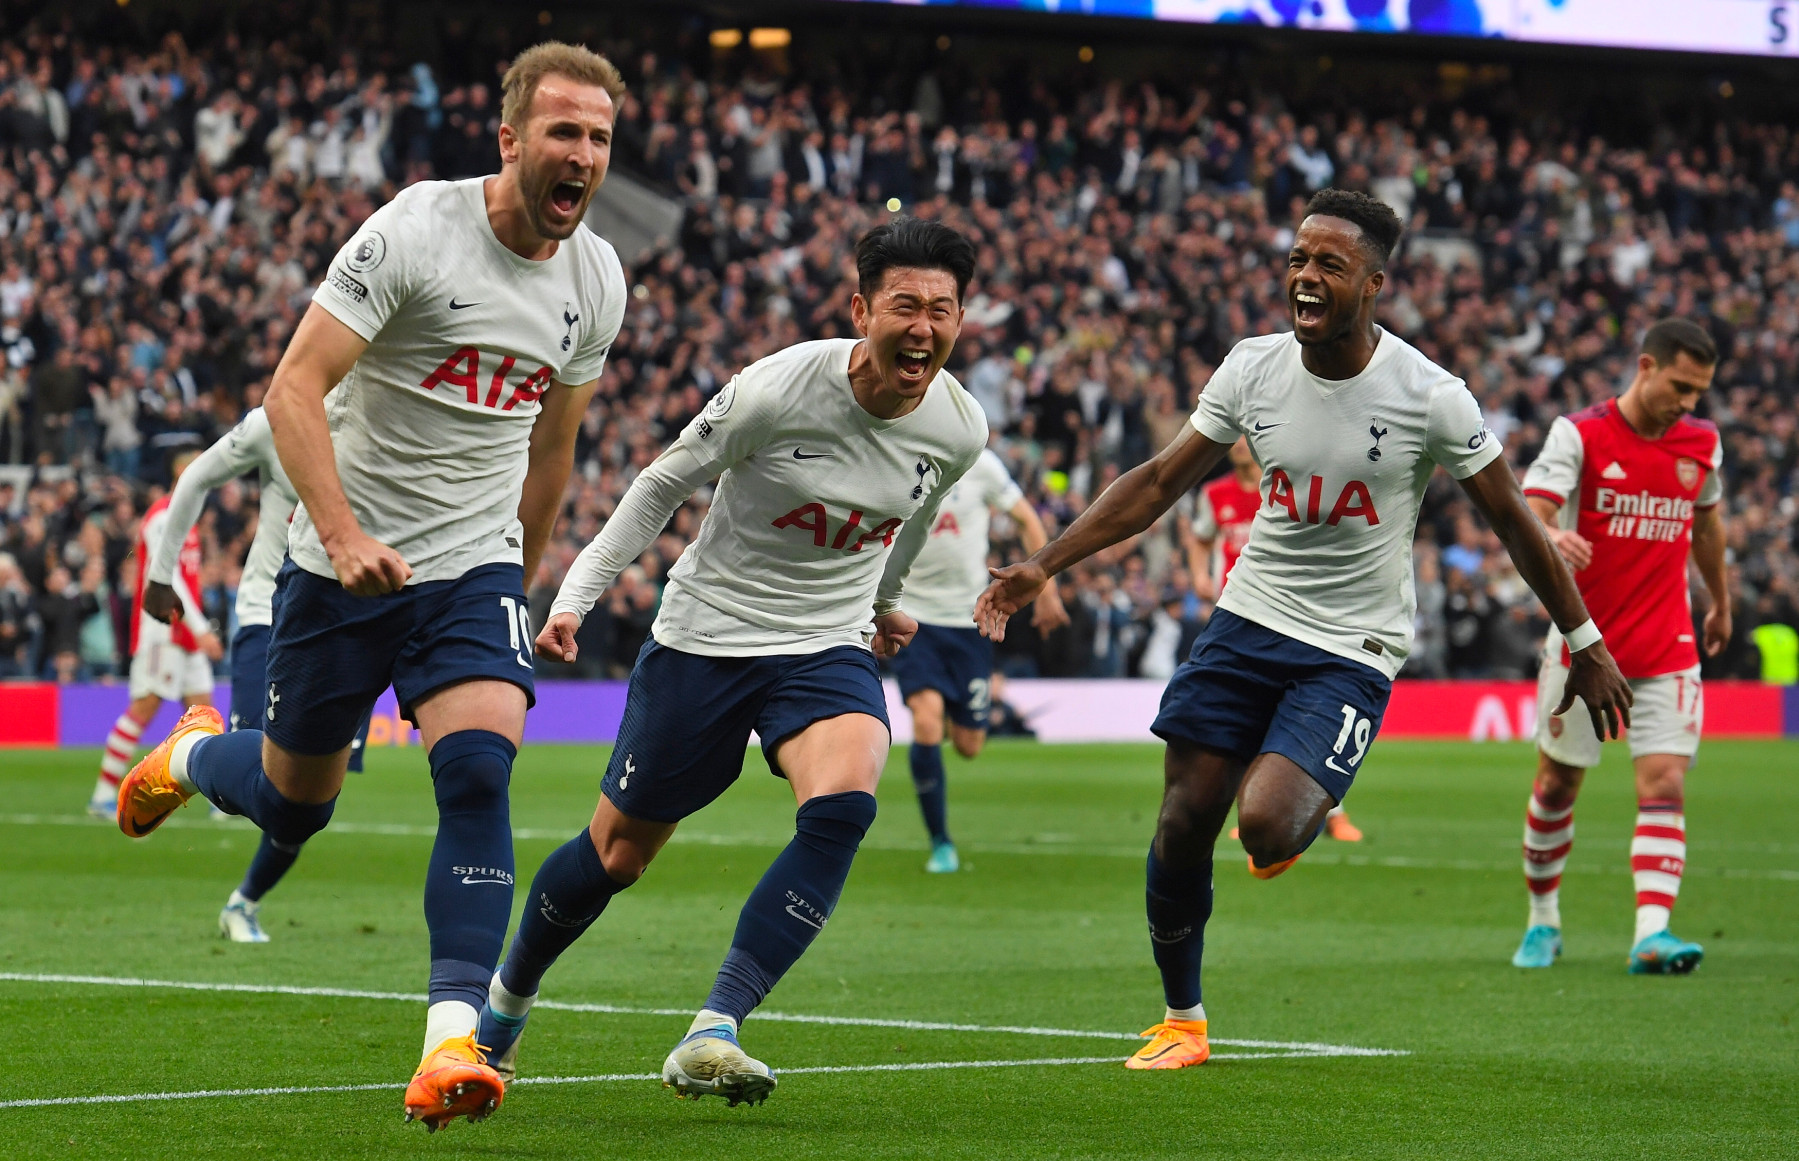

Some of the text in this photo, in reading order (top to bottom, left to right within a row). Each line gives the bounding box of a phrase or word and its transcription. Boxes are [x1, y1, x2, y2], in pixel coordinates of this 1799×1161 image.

[420, 345, 553, 411] AIA
[1268, 468, 1380, 526] AIA
[1596, 487, 1694, 520] Emirate
[771, 503, 903, 552] AIA
[1608, 515, 1637, 538] FLY
[968, 677, 991, 711] 2
[1674, 676, 1701, 715] 17
[1333, 704, 1371, 767] 19
[452, 865, 514, 885] SPURS
[785, 890, 828, 928] SPUR
